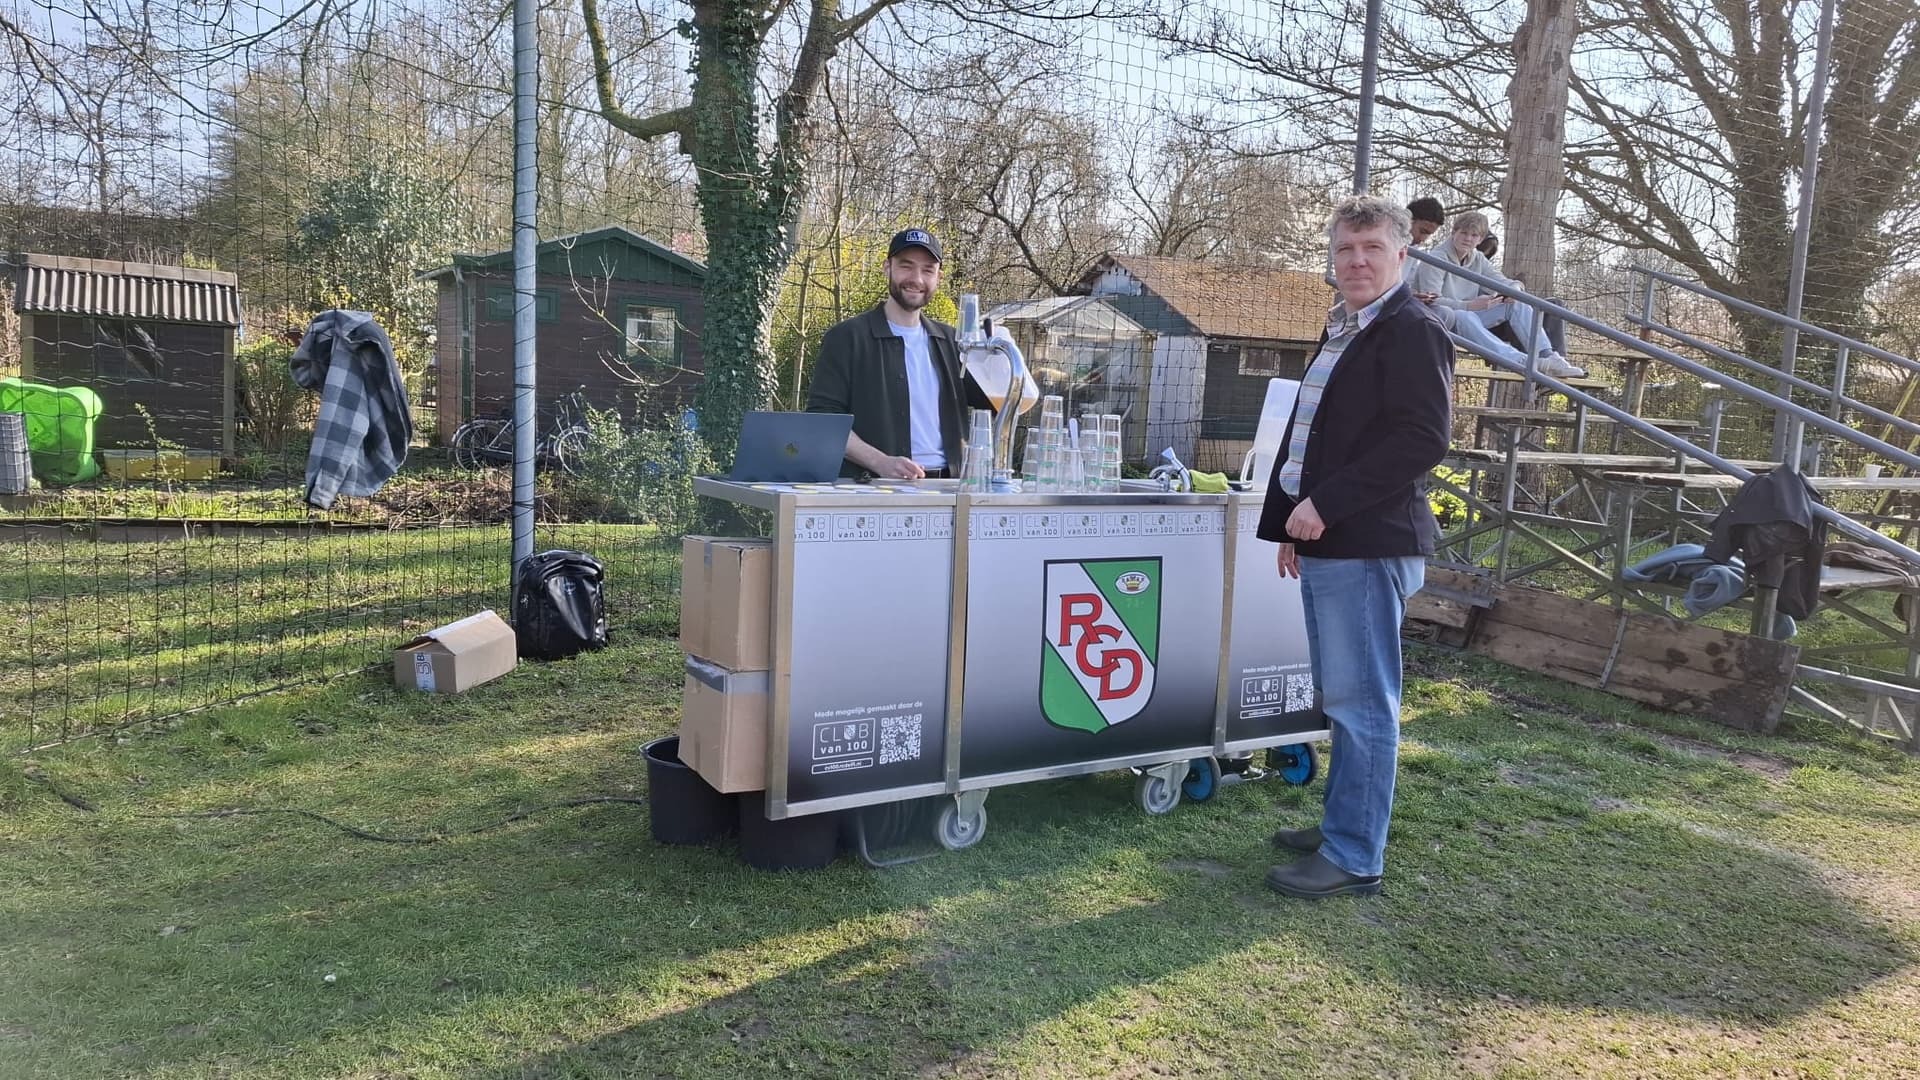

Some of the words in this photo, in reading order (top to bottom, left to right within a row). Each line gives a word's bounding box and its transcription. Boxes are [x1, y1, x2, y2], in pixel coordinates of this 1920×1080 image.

[808, 531, 825, 539] 100
[838, 531, 855, 539] van
[859, 530, 875, 538] 100
[887, 530, 903, 538] van
[1058, 592, 1144, 702] RCD
[1246, 695, 1261, 703] van
[1264, 692, 1278, 701] 100
[814, 710, 834, 718] Mede
[835, 706, 866, 716] mogelijk
[866, 703, 897, 713] gemaakt
[820, 745, 842, 754] van
[847, 740, 868, 751] 100
